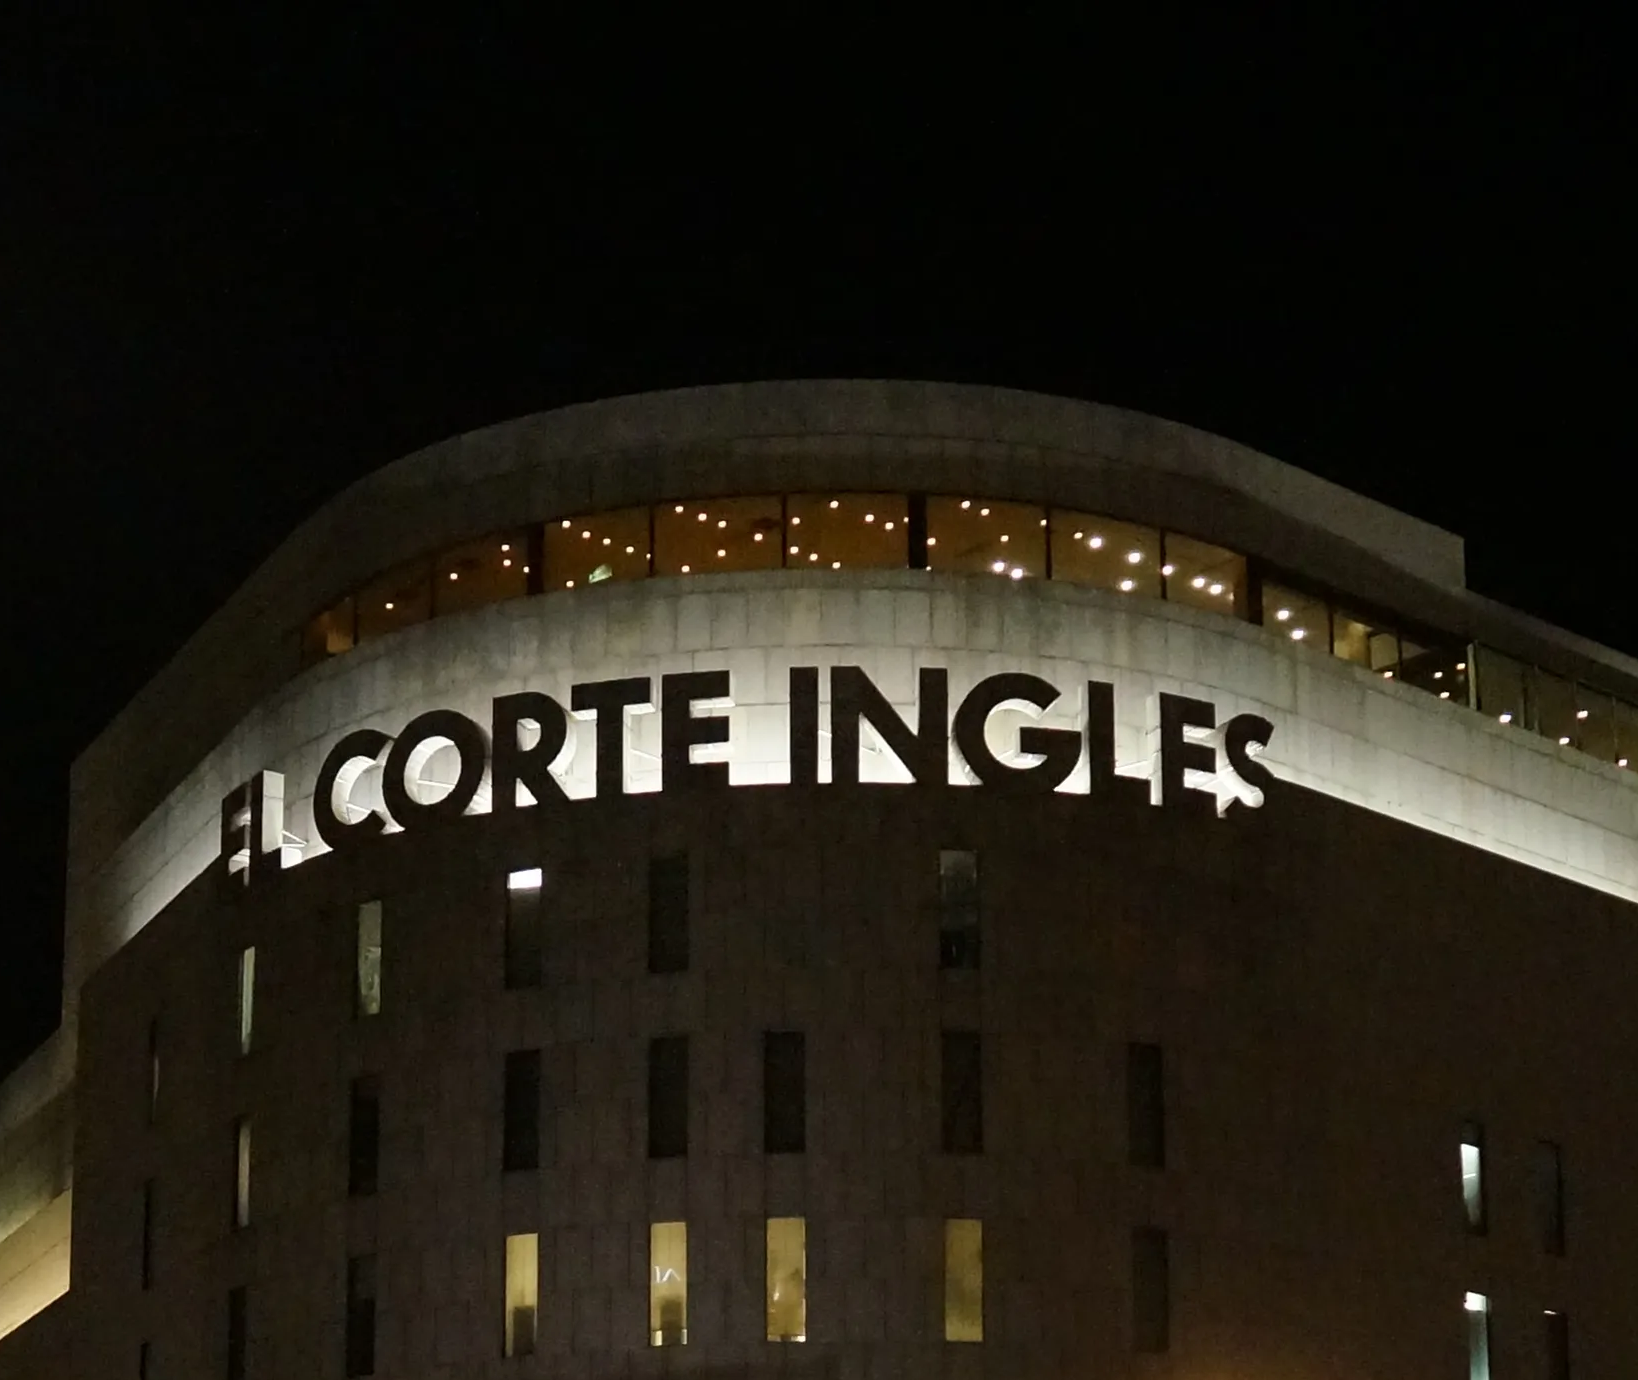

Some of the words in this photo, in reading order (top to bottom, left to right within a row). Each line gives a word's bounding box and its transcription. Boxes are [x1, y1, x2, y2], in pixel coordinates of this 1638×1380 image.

[221, 770, 283, 885] EL
[314, 670, 731, 851] CORTE
[790, 666, 1275, 816] INGLES
